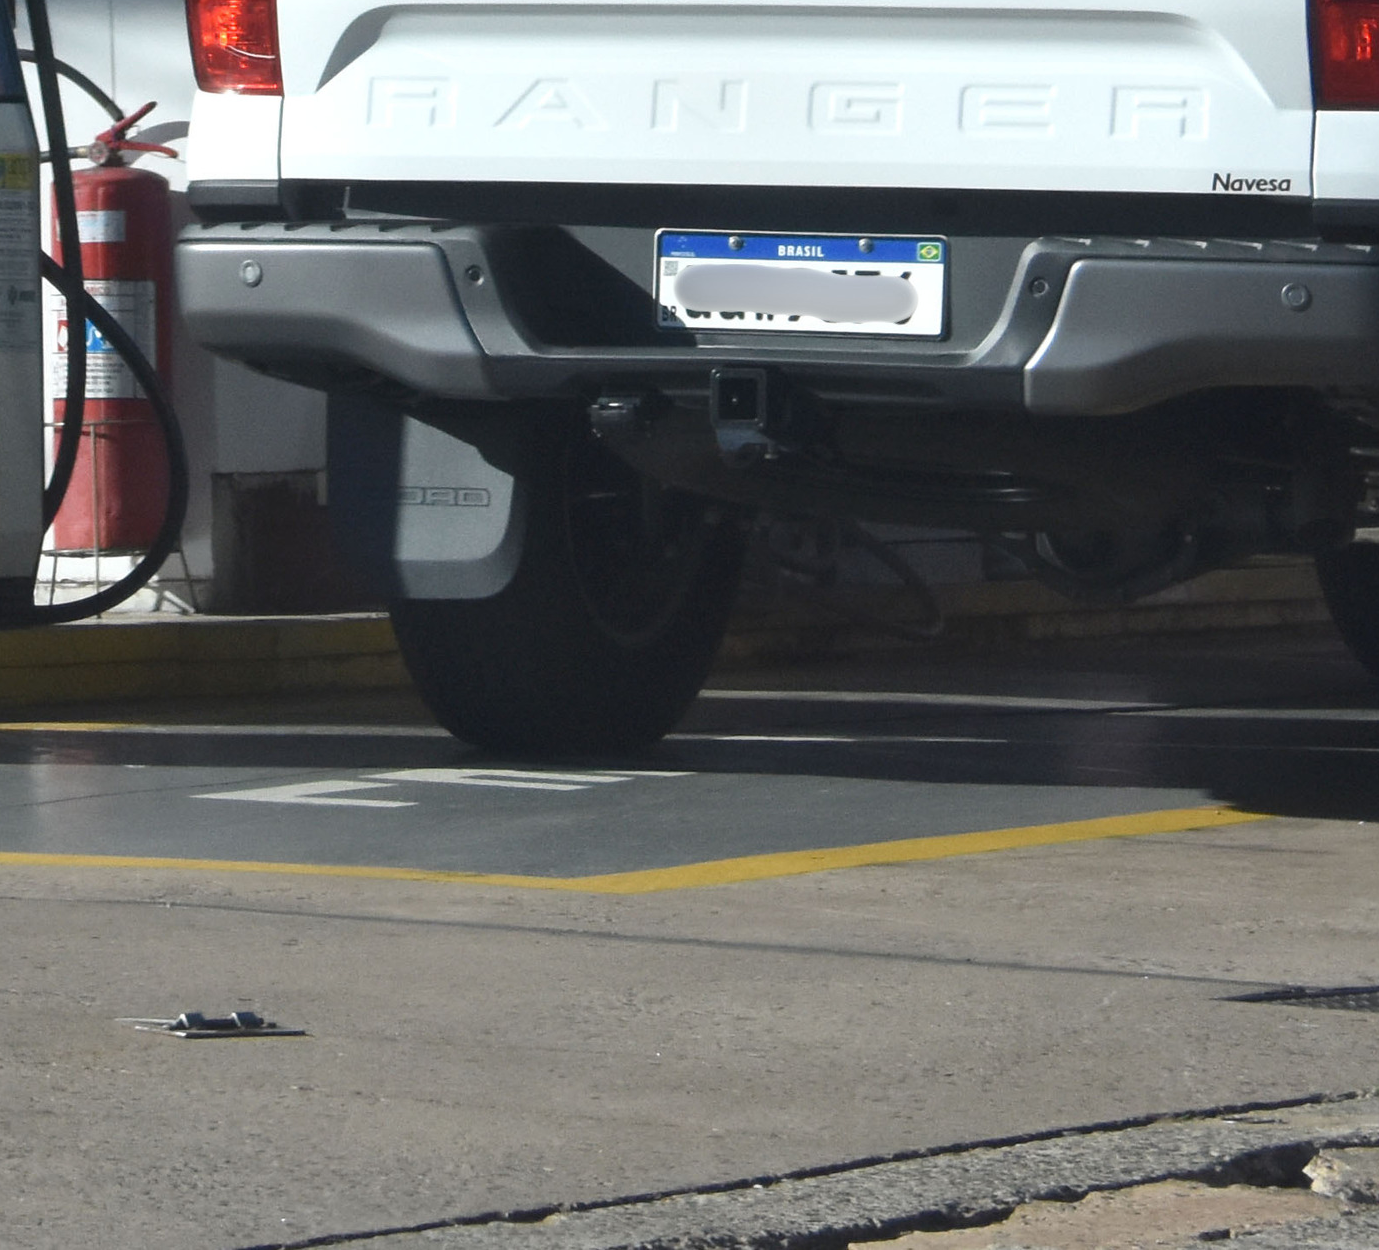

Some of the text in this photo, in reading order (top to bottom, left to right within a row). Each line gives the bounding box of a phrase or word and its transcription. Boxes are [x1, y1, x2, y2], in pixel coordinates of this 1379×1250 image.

[366, 76, 1211, 141] RANGER
[1212, 172, 1291, 194] Navesa
[778, 245, 825, 257] BRASIL
